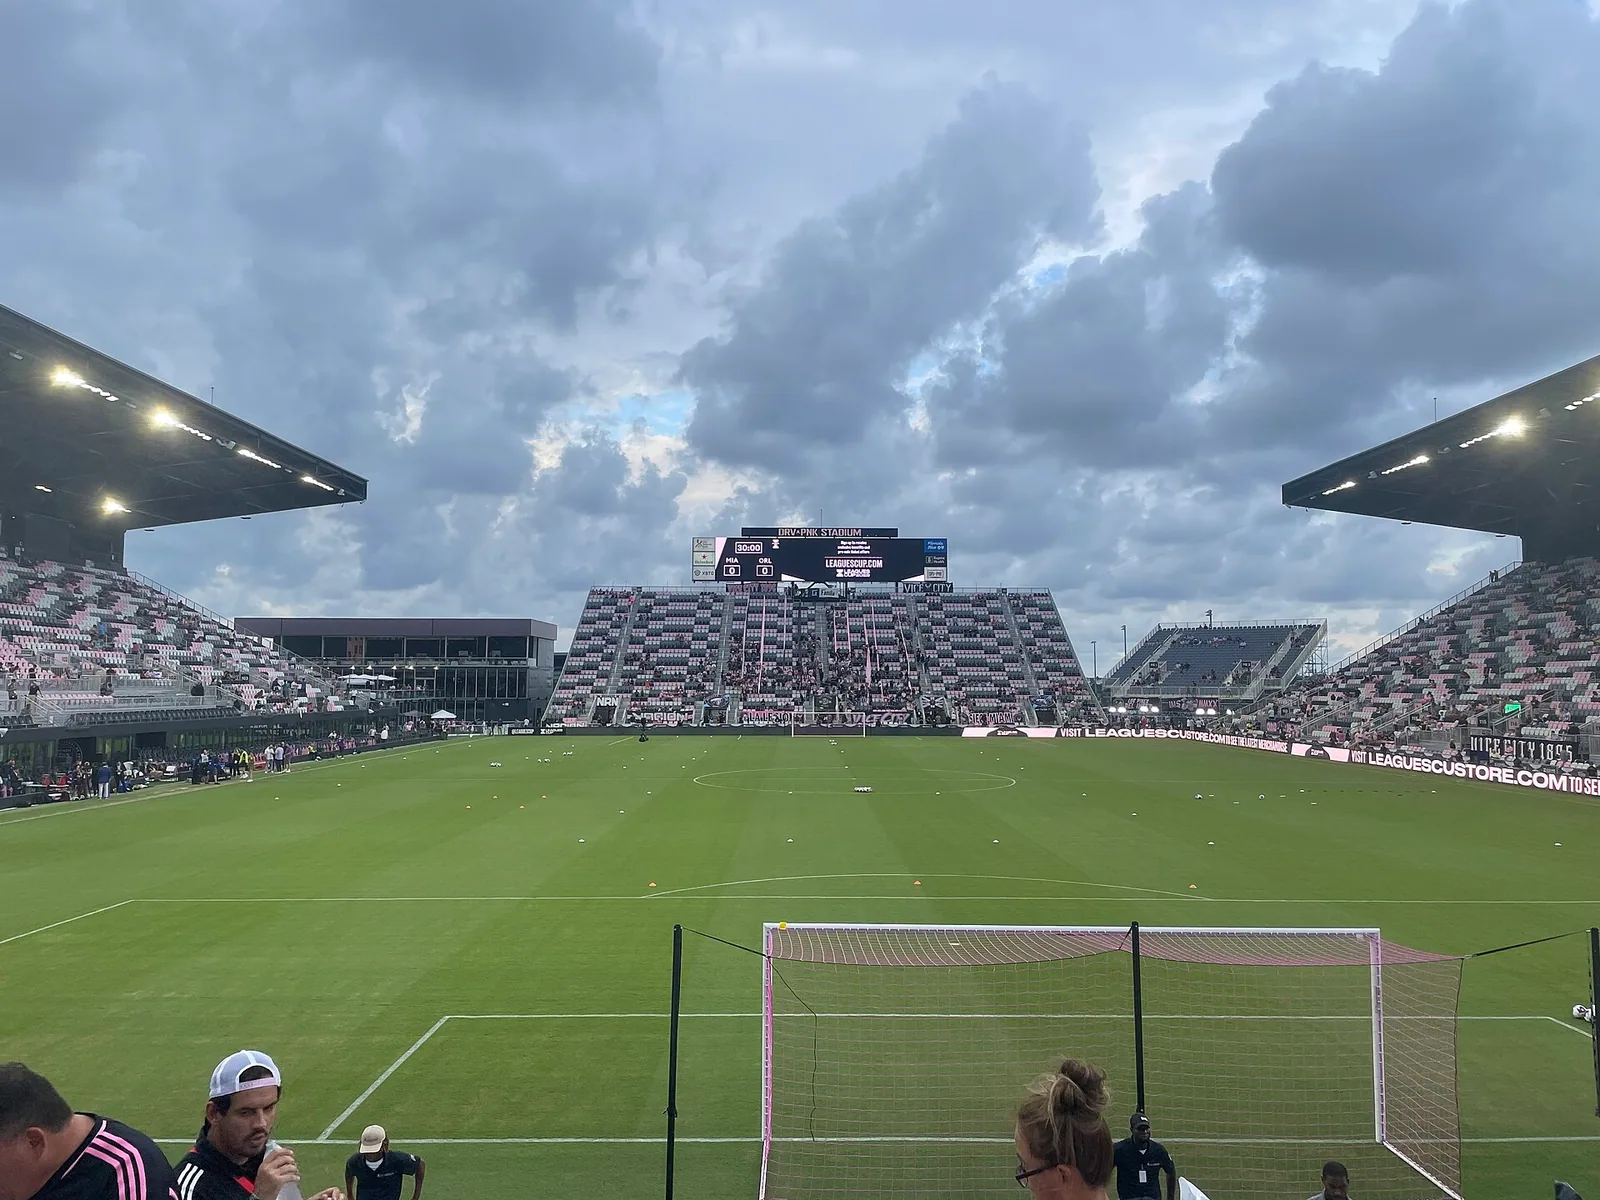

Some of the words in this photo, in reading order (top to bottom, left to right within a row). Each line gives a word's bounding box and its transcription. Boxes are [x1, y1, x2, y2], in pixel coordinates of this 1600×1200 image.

[820, 528, 862, 536] STADIUM
[737, 544, 761, 552] 30:00
[825, 559, 883, 568] LEAGUESCUP.COM
[729, 567, 736, 575] 0
[762, 567, 769, 575] 0
[904, 583, 924, 592] VICE
[932, 583, 951, 592] CITY
[596, 697, 619, 706] NRN
[1061, 728, 1082, 737] VISIT
[1085, 728, 1226, 744] LEAGUESCUSTORE.COM
[1504, 739, 1536, 759] CITY
[1350, 749, 1367, 764] VISIT
[1368, 751, 1567, 793] LEAGUESCUSTORE.COM
[1568, 776, 1583, 794] TO
